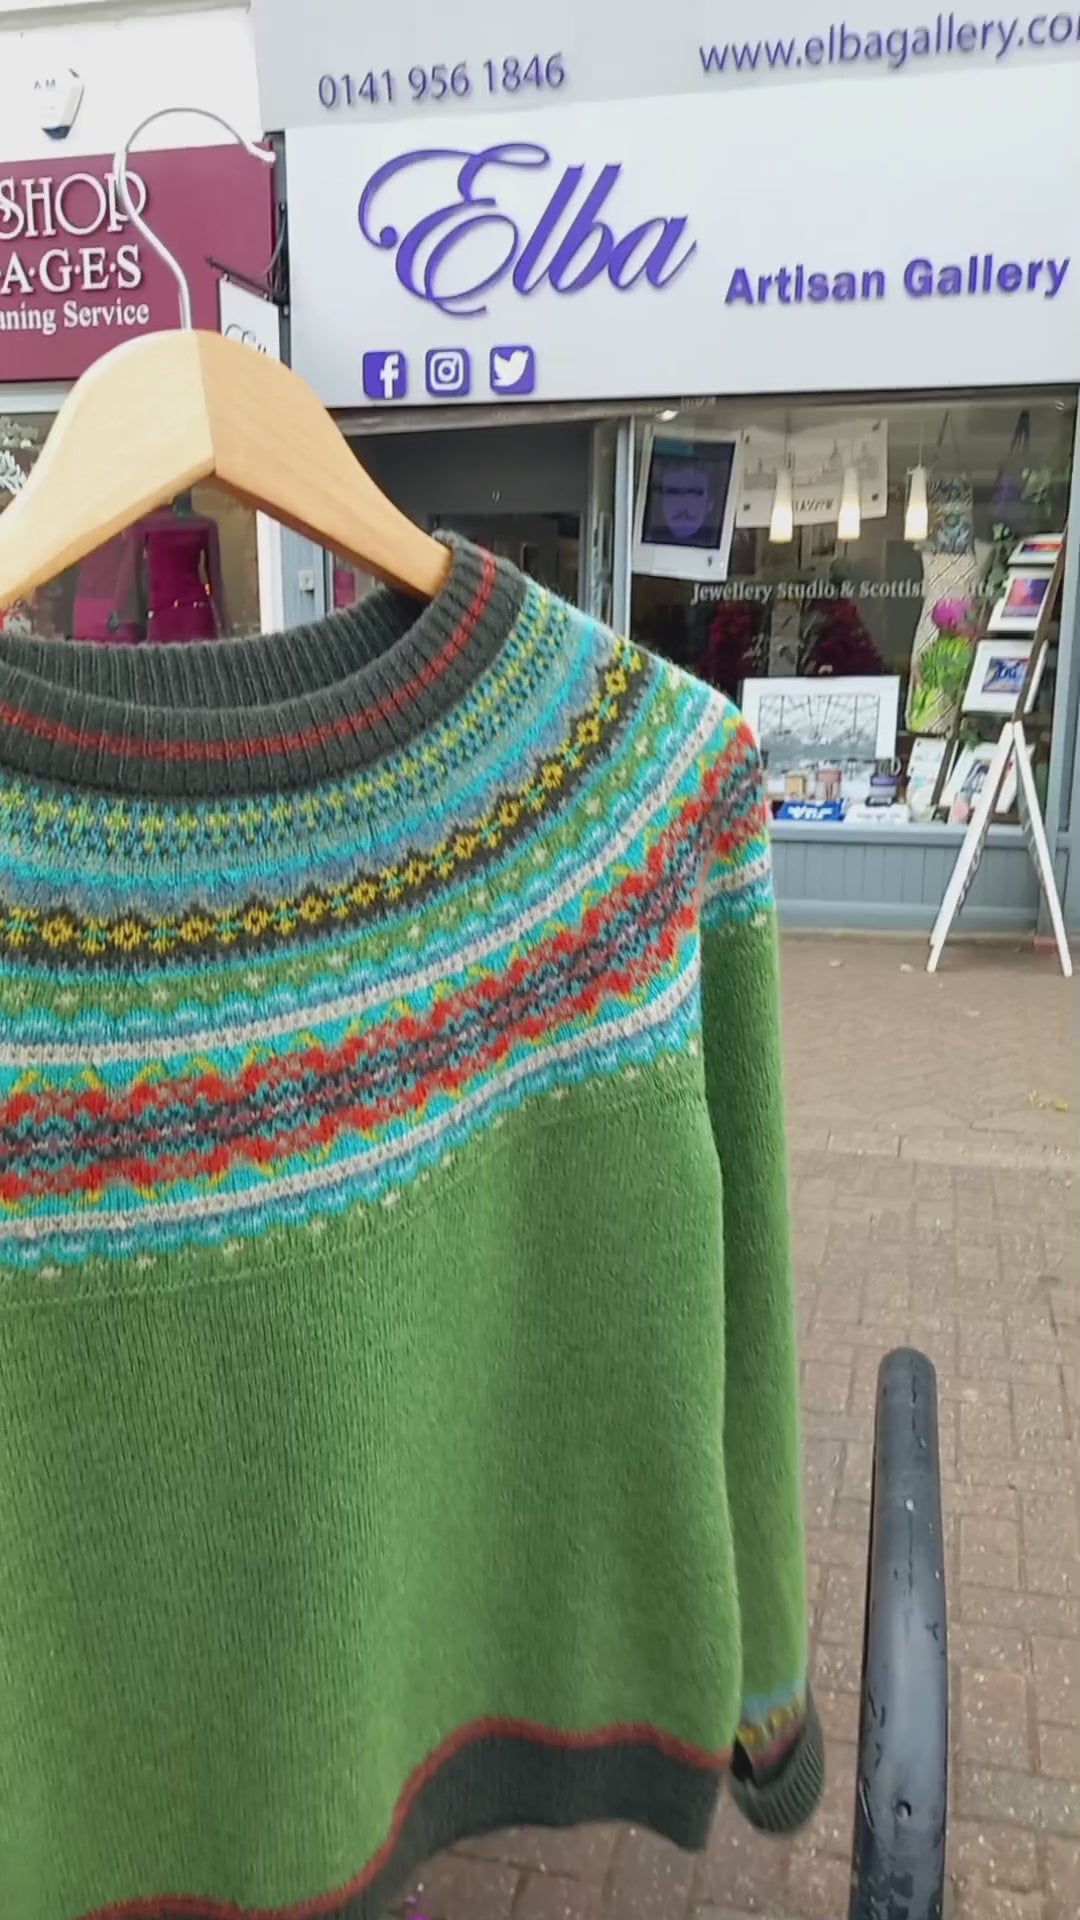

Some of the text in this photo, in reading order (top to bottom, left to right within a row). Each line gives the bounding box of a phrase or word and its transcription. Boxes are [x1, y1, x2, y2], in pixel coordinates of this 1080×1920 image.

[699, 11, 1080, 72] www.elbagallery.co
[318, 51, 566, 109] 0141 956 1846
[358, 142, 697, 316] Elba
[725, 254, 1070, 305] Artisan Gallery
[63, 297, 149, 328] Service
[690, 582, 773, 606] Jewellery
[777, 580, 835, 600] Studio
[840, 580, 853, 599] &
